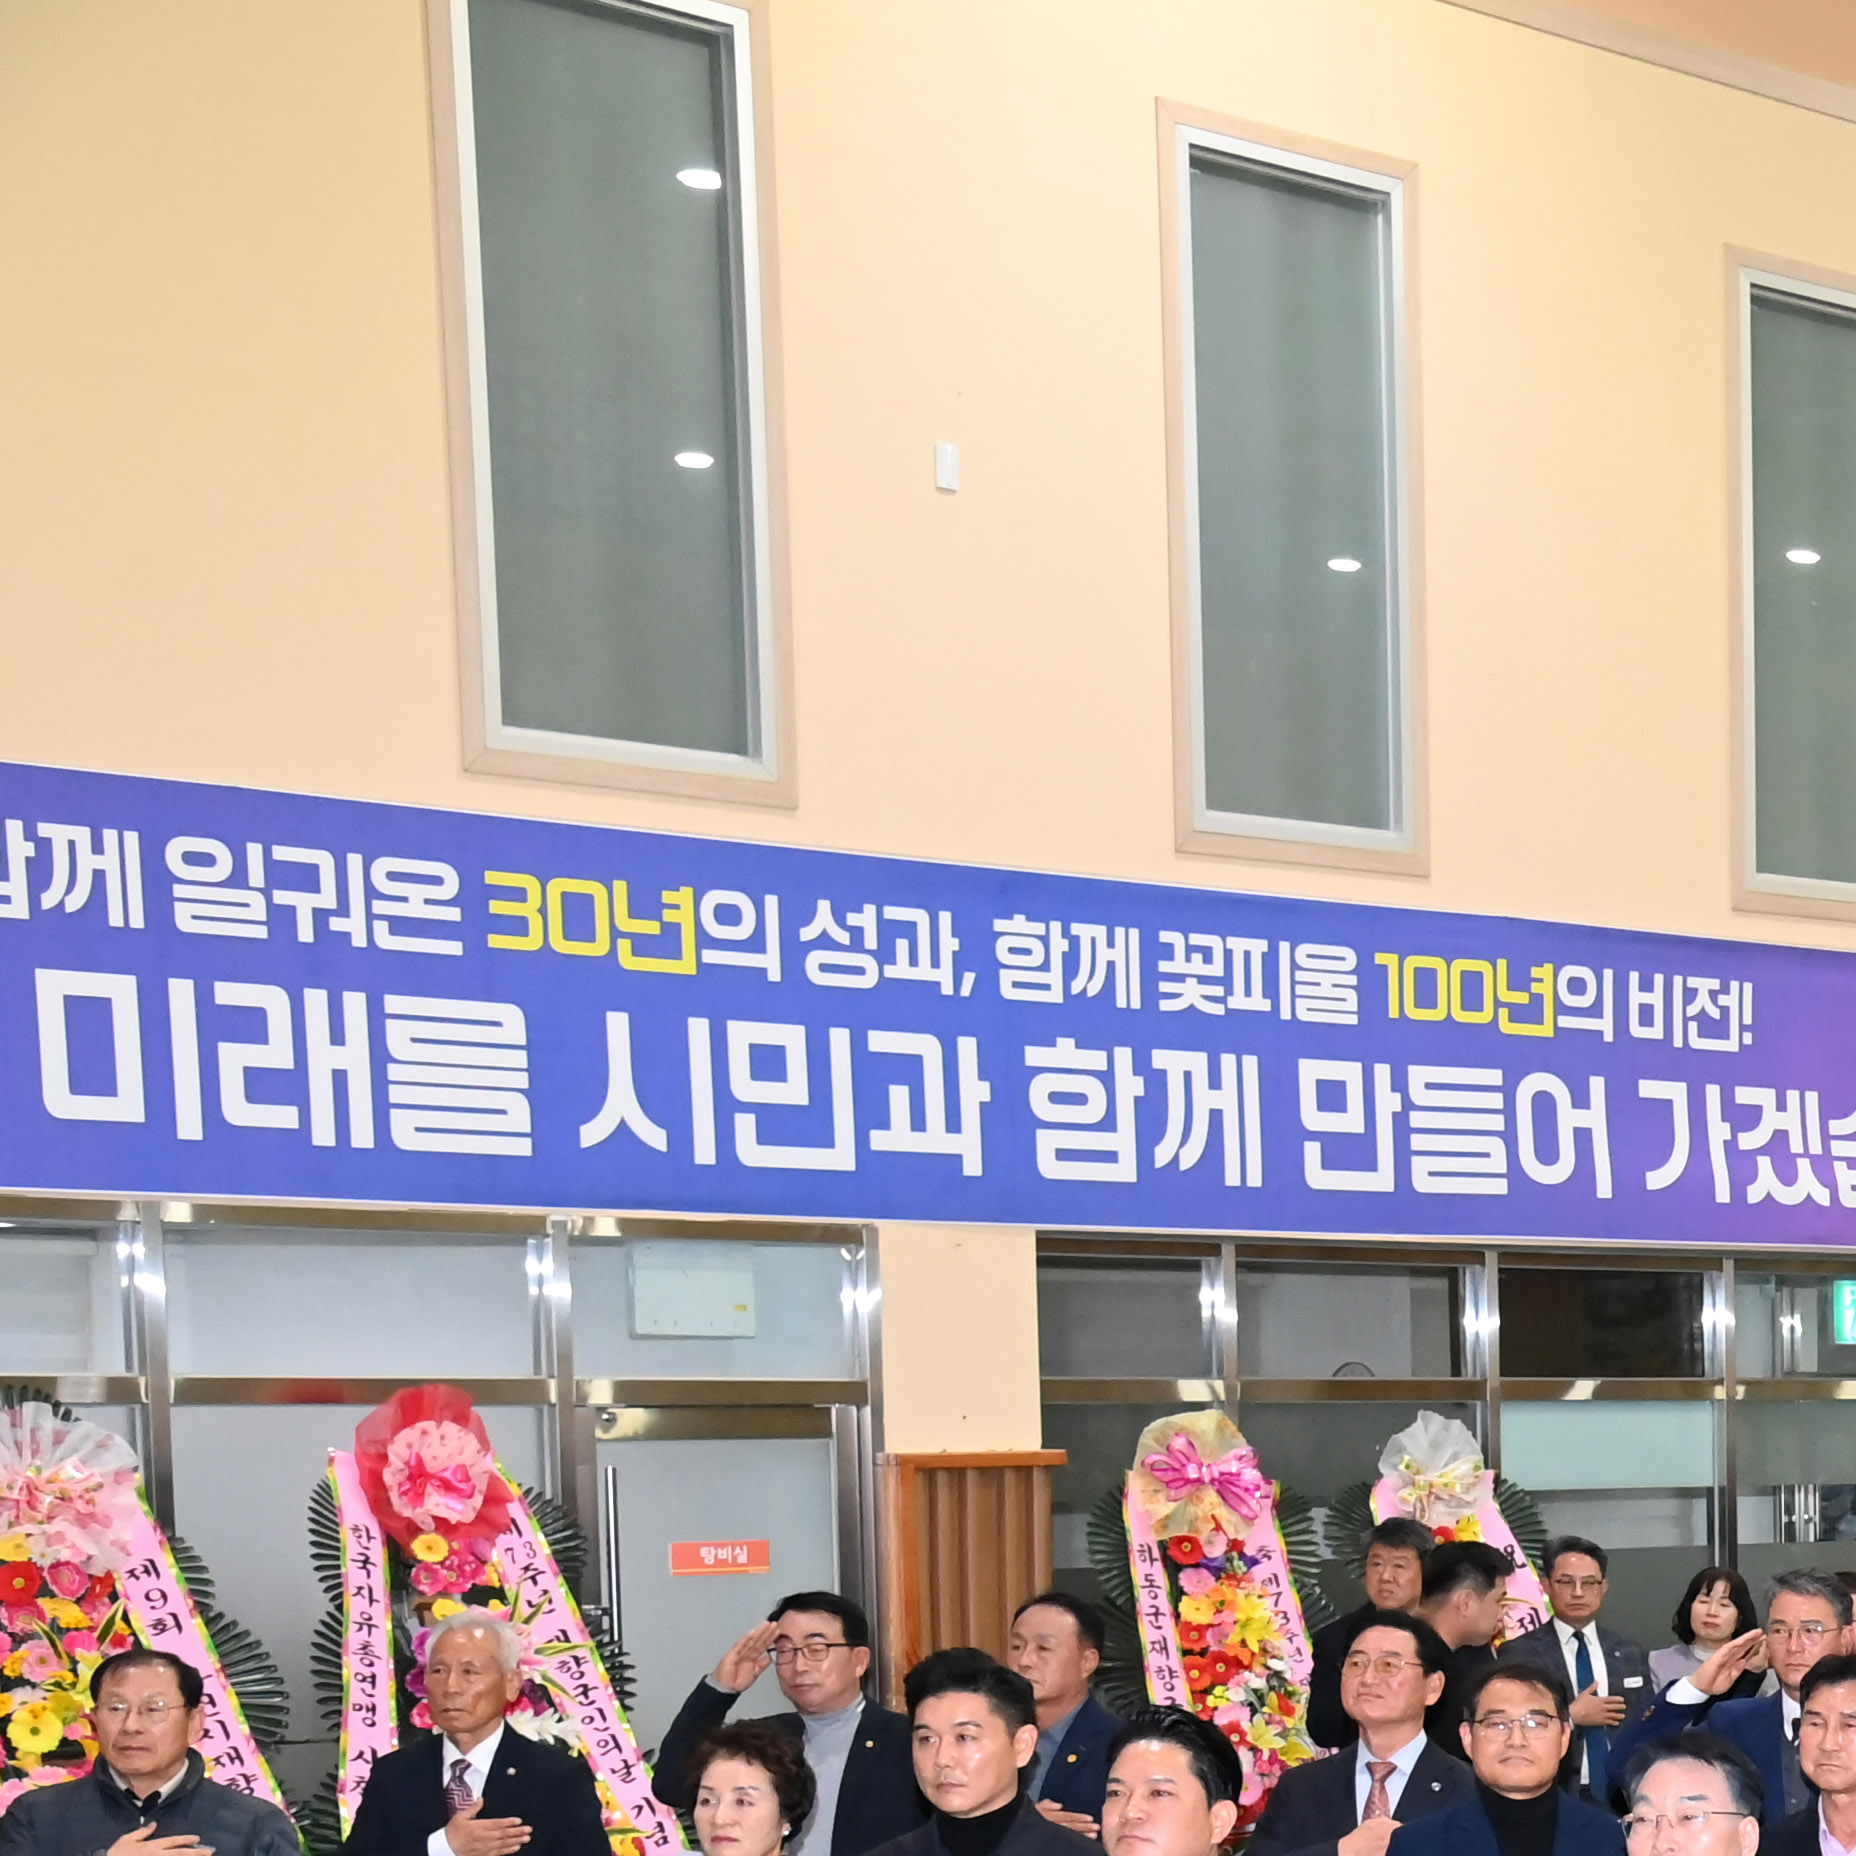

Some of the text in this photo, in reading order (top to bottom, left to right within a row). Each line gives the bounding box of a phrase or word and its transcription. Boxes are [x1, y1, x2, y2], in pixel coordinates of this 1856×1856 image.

[164, 836, 463, 955] 일궈온
[484, 871, 781, 982] 30년의
[799, 899, 976, 997] 성과,
[993, 914, 1142, 1010] 함께
[1158, 930, 1358, 1025] 꽃피울
[1374, 952, 1614, 1042] 100년의
[1629, 970, 1753, 1052] 비전!
[35, 968, 533, 1157] 미래를
[579, 1011, 991, 1176] 시민과
[1024, 1037, 1262, 1187] 함께
[1298, 1058, 1613, 1199] 만들어
[349, 1523, 382, 1728] 한국자유총연맹
[699, 1544, 748, 1565] 탕비실
